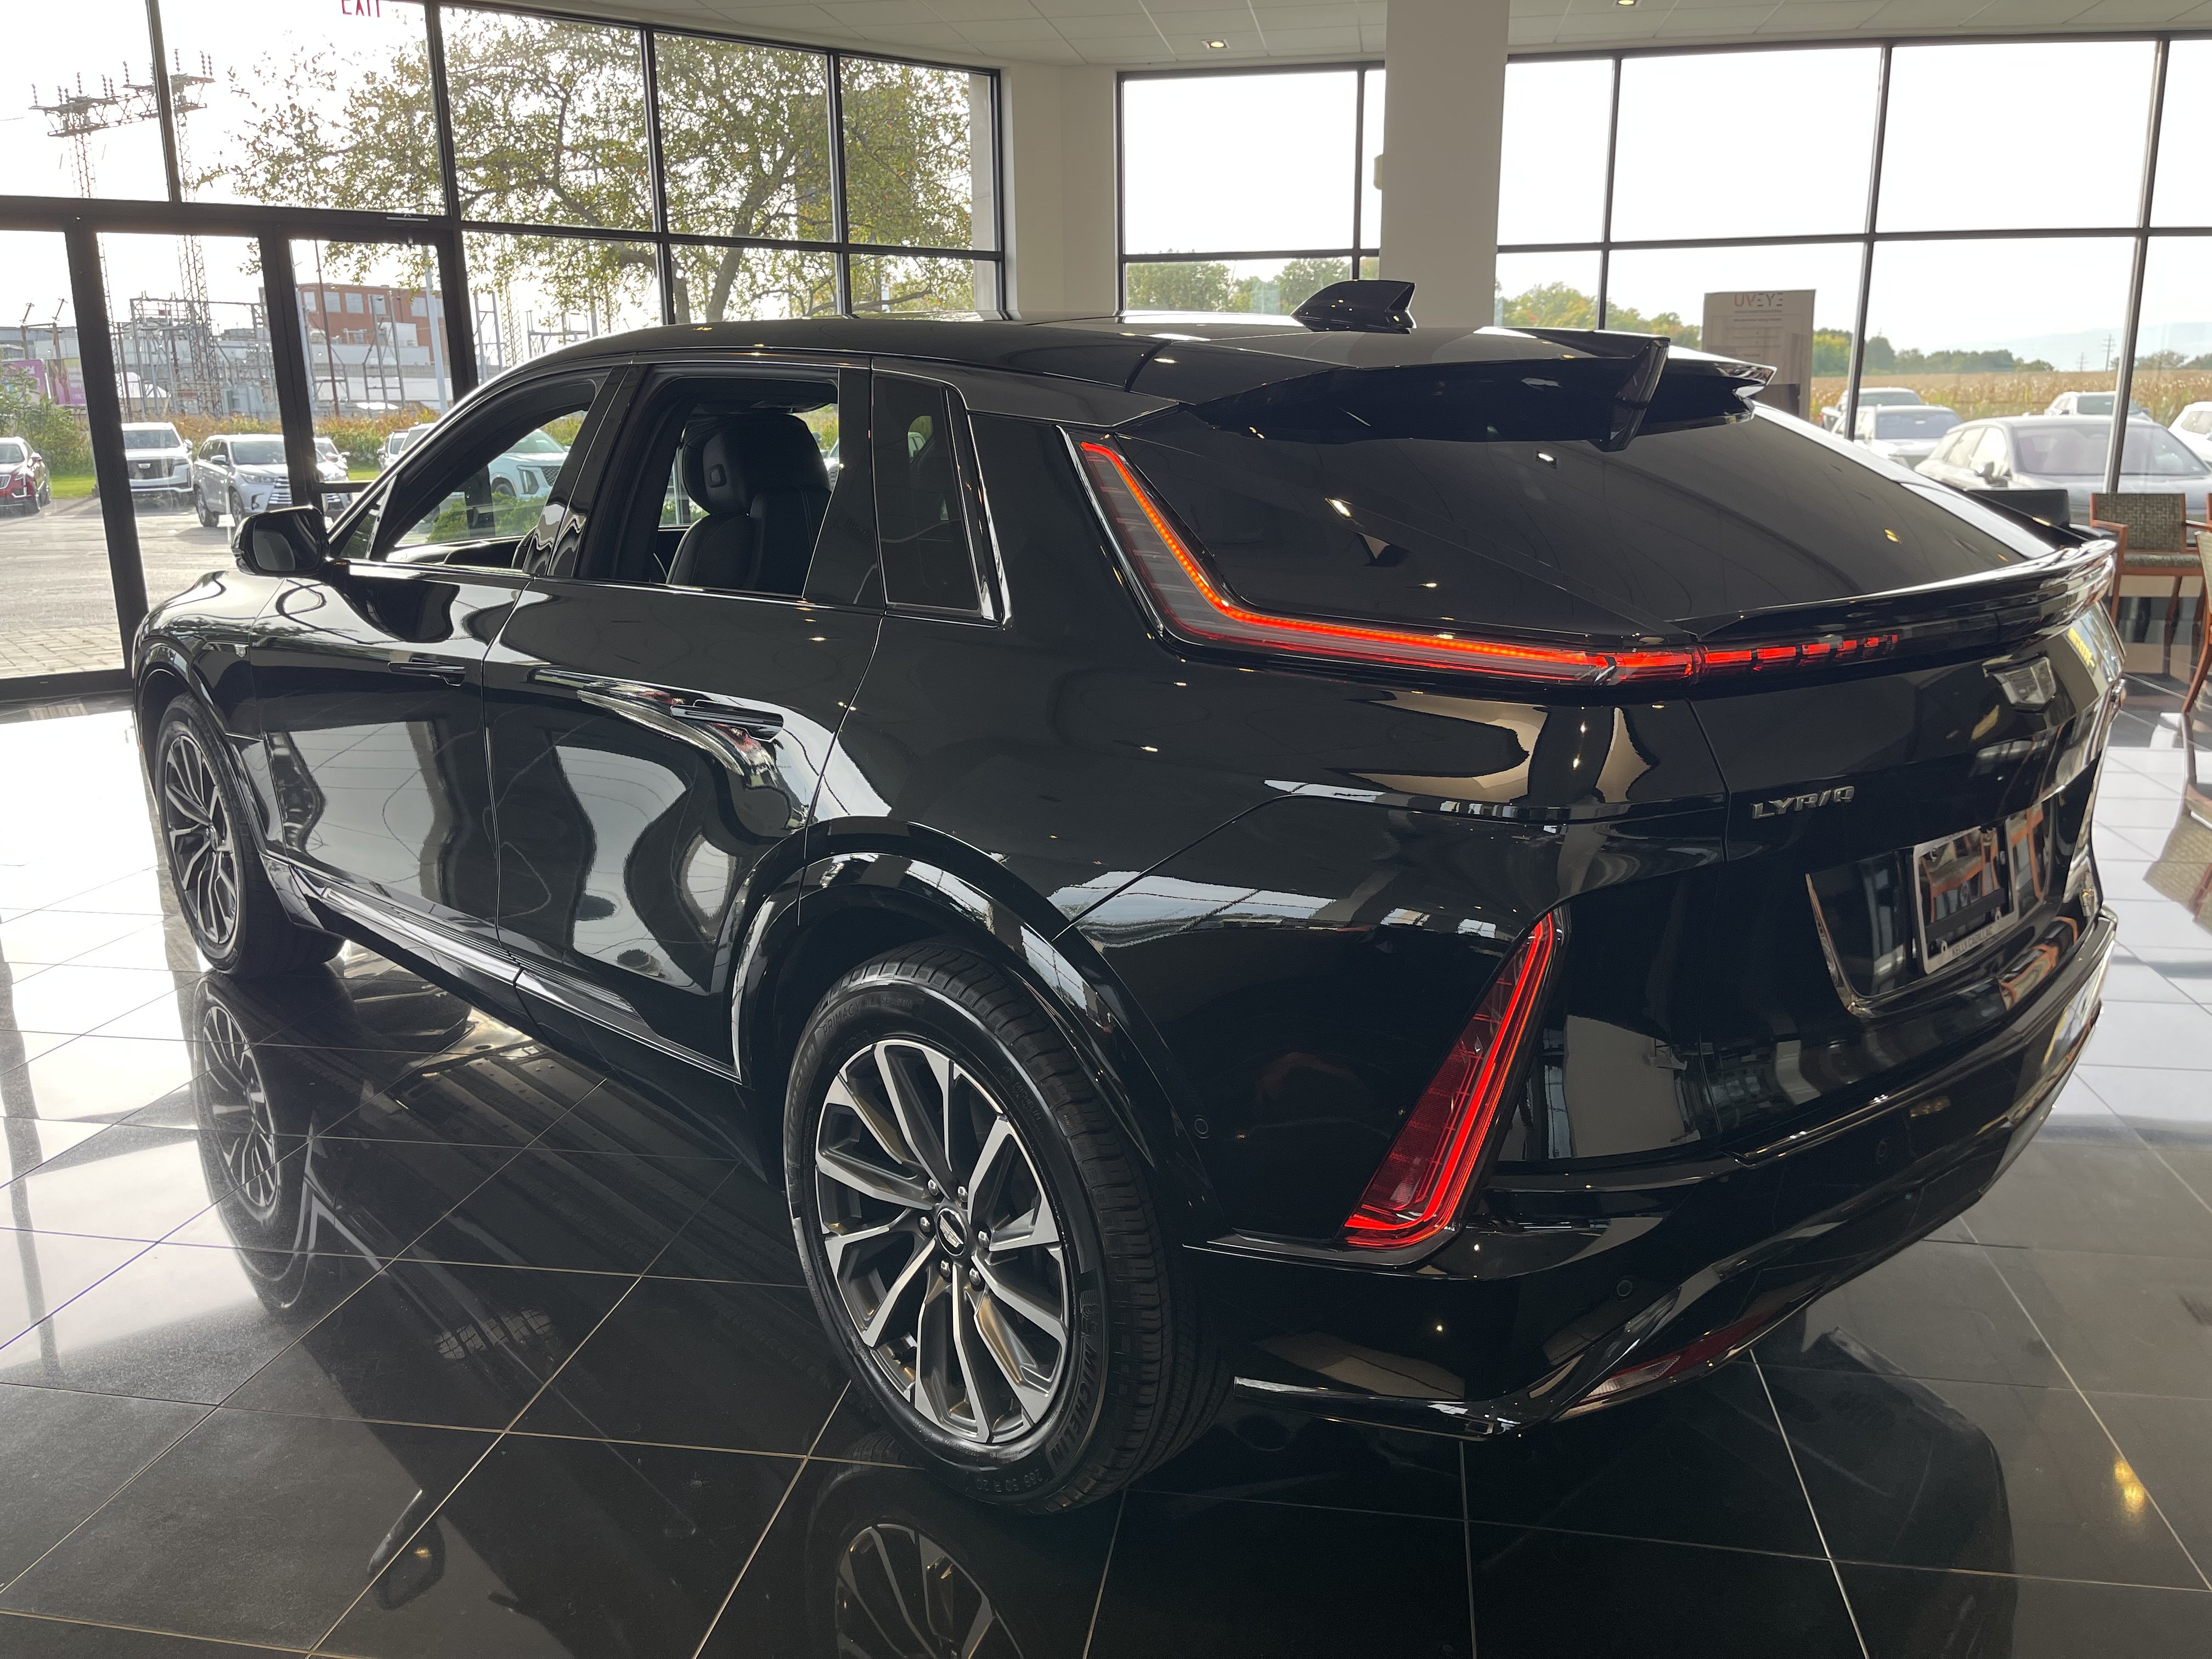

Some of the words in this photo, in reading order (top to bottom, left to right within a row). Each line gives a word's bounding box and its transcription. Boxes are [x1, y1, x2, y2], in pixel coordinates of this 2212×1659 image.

[1752, 786, 1855, 819] LYRIQ
[822, 1001, 862, 1037] PRIMACY
[865, 996, 878, 1006] ALL
[882, 995, 913, 1007] SEASON
[1014, 1081, 1042, 1121] MICHELIN
[1049, 1342, 1098, 1465] MICHELIN
[1005, 1478, 1019, 1492] 50
[1023, 1469, 1043, 1487] 265
